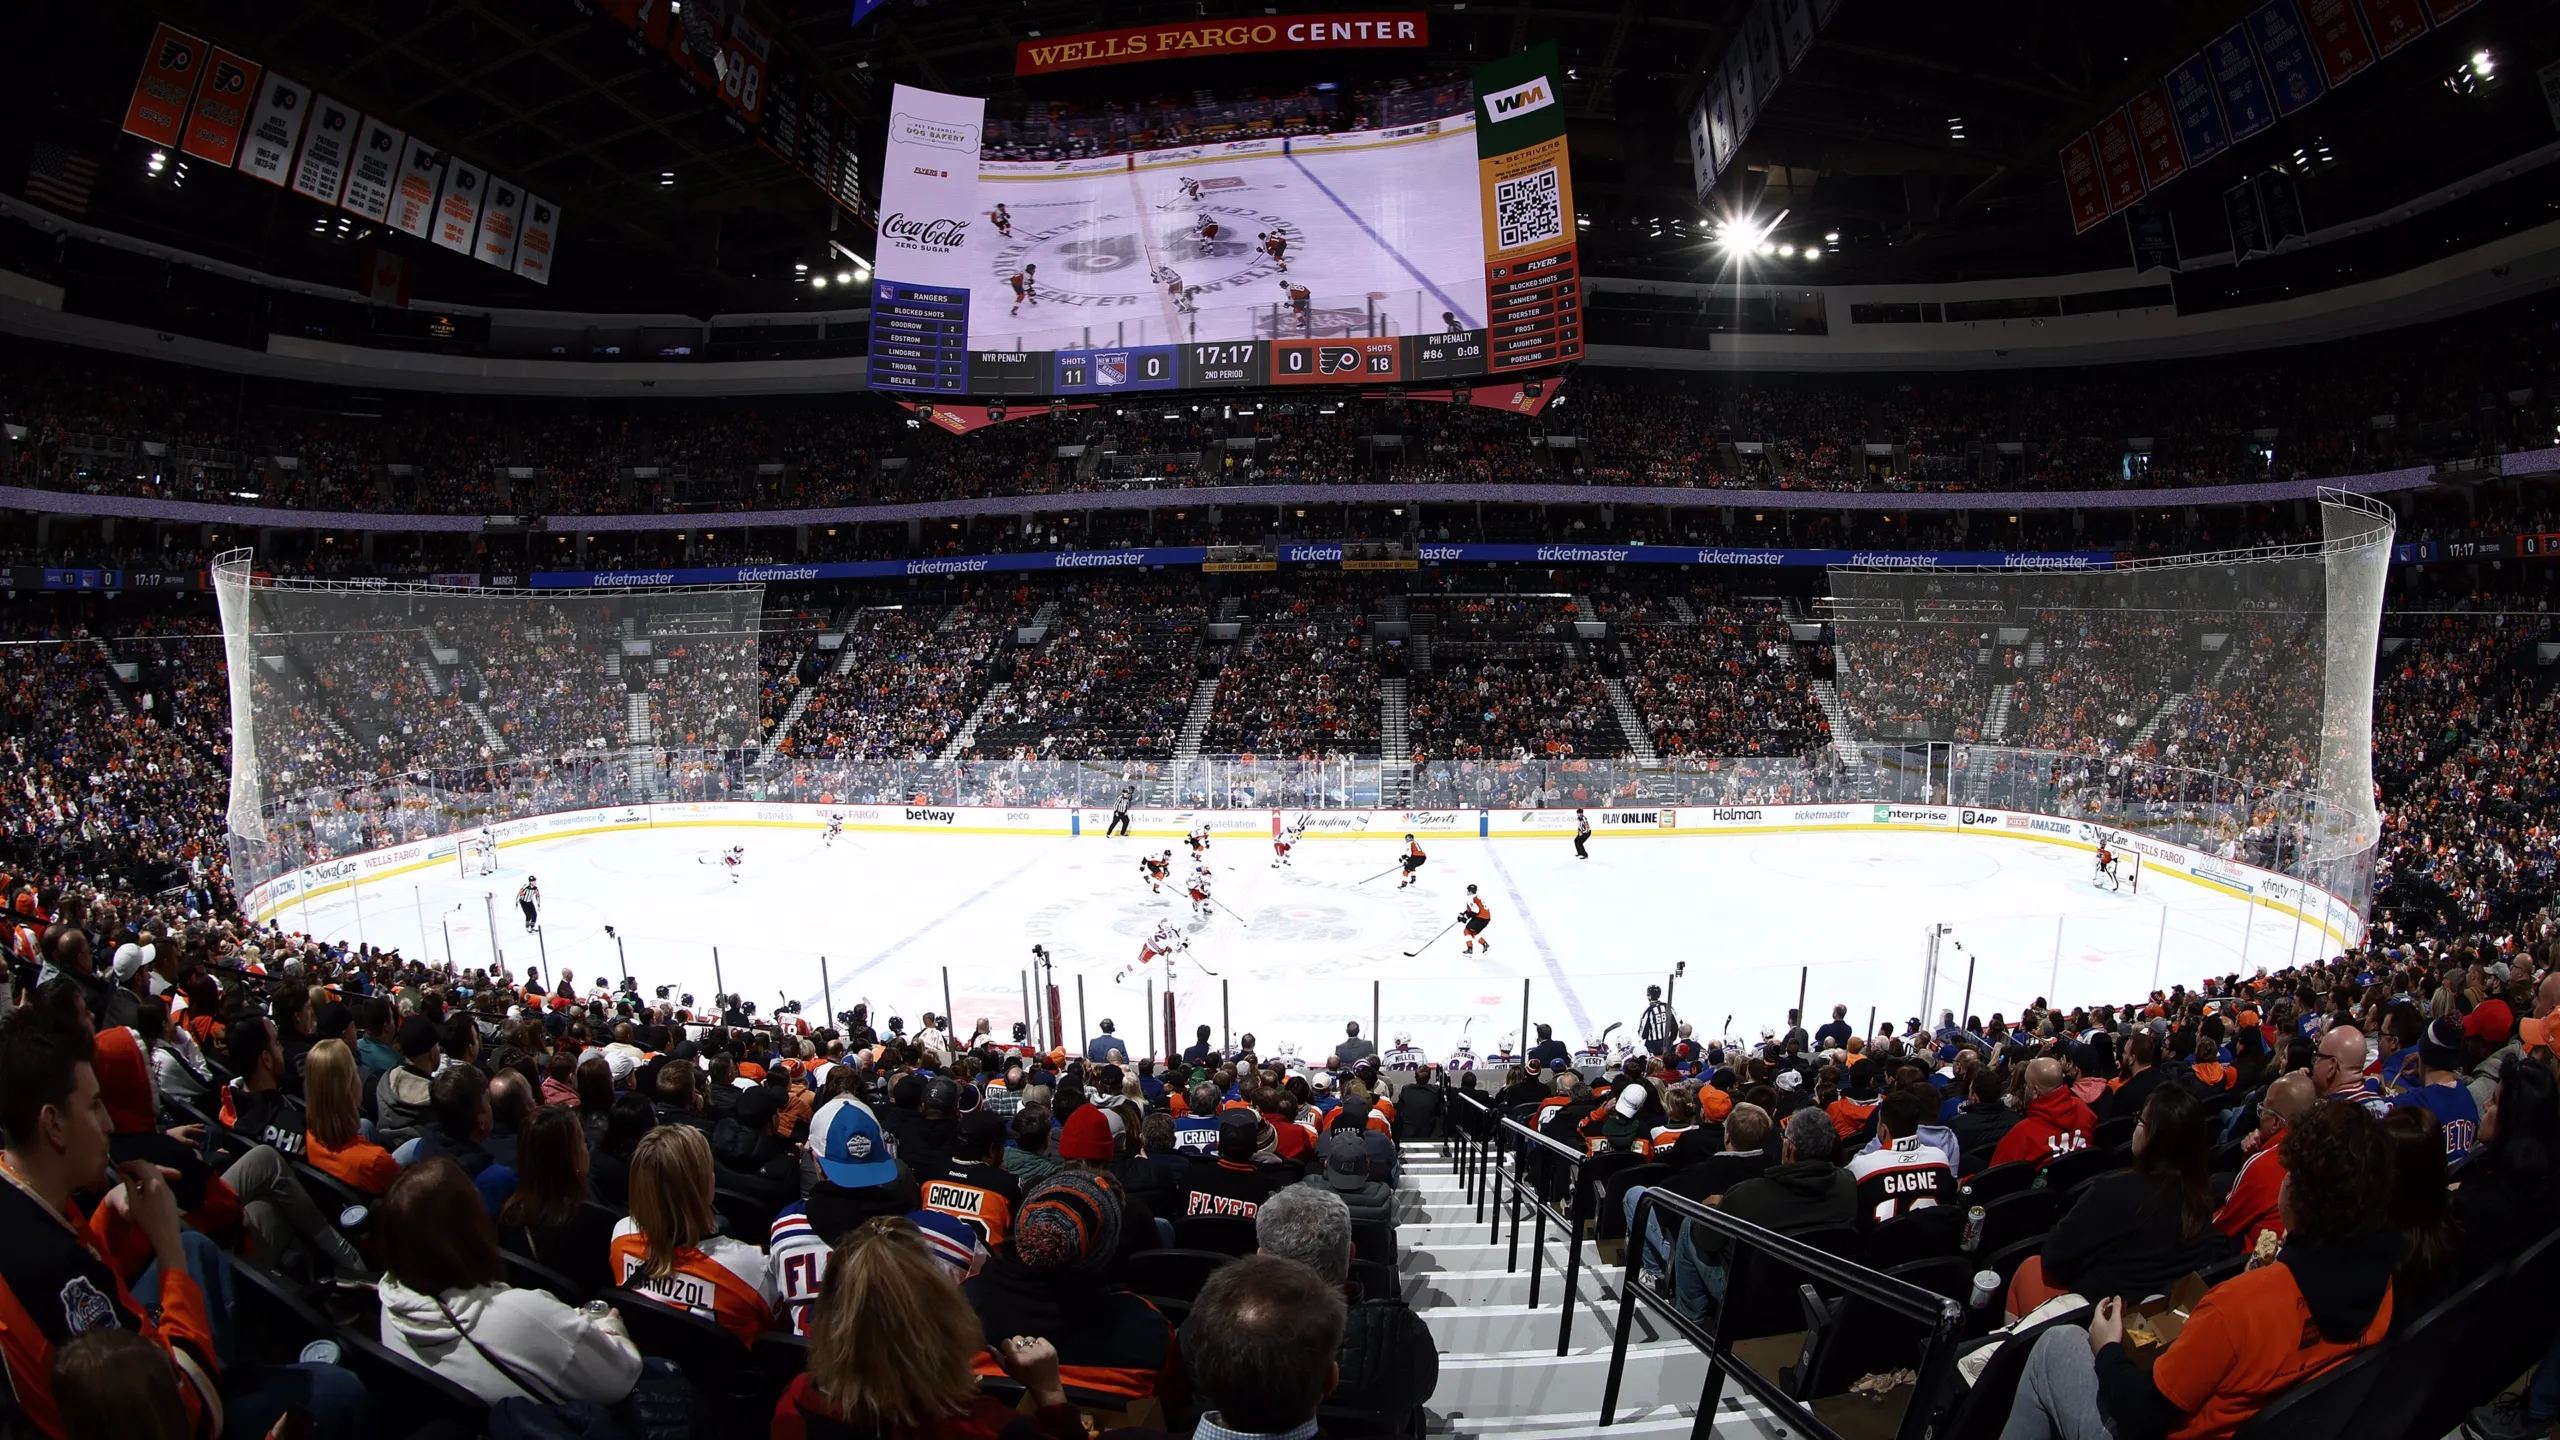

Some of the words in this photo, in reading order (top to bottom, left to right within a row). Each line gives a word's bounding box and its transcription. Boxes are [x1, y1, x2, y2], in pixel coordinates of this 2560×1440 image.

[2389, 17, 2405, 34] 76
[1028, 34, 1148, 67] WELLS
[1156, 25, 1277, 53] FARGO
[1287, 21, 1417, 42] CENTER
[2263, 24, 2298, 54] CHAMPIONS
[2339, 48, 2353, 65] 76
[725, 50, 760, 112] 88
[1736, 68, 1745, 95] 3
[1494, 86, 1545, 114] WM
[906, 127, 926, 137] DOG
[929, 131, 965, 142] BAKERY
[1506, 140, 1560, 162] BETRIVERS
[2160, 156, 2170, 171] 76
[882, 213, 971, 247] Coca-Cola
[895, 241, 917, 250] ZERO
[920, 244, 950, 253] SUGAR
[1527, 256, 1557, 271] FLYERS
[1510, 279, 1538, 291] BLOCKED
[1538, 275, 1558, 285] SHOTS
[913, 293, 947, 303] RANGERS
[1509, 294, 1538, 305] SANHEIM
[894, 307, 923, 317] BLOCKED
[924, 310, 945, 319] SHOTS
[1508, 308, 1540, 320] FOERSTER
[891, 321, 922, 330] GOODROW
[1515, 323, 1535, 333] FROST
[891, 335, 920, 344] EDSTROM
[1429, 335, 1442, 345] PHI
[1442, 332, 1472, 344] PENALTY
[1508, 338, 1542, 349] LAUGHTON
[889, 348, 921, 357] LINDGREN
[1196, 345, 1253, 365] 17:17
[1366, 344, 1392, 352] SHOTS
[1422, 350, 1443, 360] #86
[1457, 346, 1480, 357] 0:08
[982, 353, 997, 362] NYR
[997, 353, 1027, 363] PENALTY
[1061, 357, 1086, 365] SHOTS
[1110, 356, 1125, 364] YORK
[1289, 352, 1302, 371] 0
[1371, 357, 1389, 371] 18
[1510, 352, 1542, 363] POEHLING
[891, 362, 917, 371] TROUBA
[1101, 364, 1125, 382] RANGERS
[1147, 358, 1160, 377] 0
[890, 377, 916, 385] BELZILE
[1065, 370, 1081, 383] 11
[1205, 371, 1218, 380] 2ND
[1219, 369, 1243, 379] PERIOD
[2421, 545, 2427, 558] 0
[2448, 543, 2474, 557] 17:17
[2527, 538, 2534, 552] 0
[1054, 551, 1144, 568] ticketmaster
[1537, 546, 1628, 563] ticketmaster
[1698, 550, 1784, 565] ticketmaster
[1852, 553, 1938, 568] ticketmaster
[906, 558, 987, 574] ticketmaster
[2004, 555, 2088, 570] ticketmaster
[65, 574, 74, 584] 11
[105, 573, 112, 585] 0
[135, 573, 160, 586] 17:17
[493, 576, 511, 586] MARCH
[513, 576, 518, 585] 7
[593, 573, 674, 587] ticketmaster
[737, 567, 818, 582] ticketmaster
[349, 577, 388, 587] FLYERS
[757, 804, 792, 812] COMCAST
[849, 810, 879, 819] FARGO
[1713, 808, 1762, 821] Holman
[1794, 810, 1850, 820] ticketmaster
[549, 814, 597, 826] Independence
[757, 811, 794, 820] BUSINESS
[905, 808, 955, 824] betway
[1007, 811, 1030, 822] peco
[1293, 811, 1351, 828] Yuengling
[1417, 811, 1458, 825] Sports
[1602, 812, 1620, 824] PLAY
[1621, 812, 1658, 824] ONLINE
[1877, 808, 1947, 823] enterprise
[511, 821, 538, 835] mobile
[2030, 819, 2071, 835] AMAZING
[2091, 825, 2128, 846] NovaCare
[364, 853, 393, 868] WELLS
[394, 848, 421, 863] FARGO
[2134, 841, 2158, 858] WELLS
[2159, 848, 2185, 866] FARGO
[315, 860, 358, 881] NovaCare
[268, 879, 296, 899] AMAZING
[2261, 878, 2290, 896] xfinity
[1655, 1013, 1667, 1023] 68
[1395, 1054, 1415, 1062] MILLER
[1334, 1127, 1360, 1135] FLYERS
[262, 1124, 306, 1156] PHI
[948, 1170, 968, 1179] Reebok
[1884, 1171, 1937, 1194] GAGNE
[930, 1186, 980, 1212] GIROUX
[1874, 1196, 1939, 1223] 1
